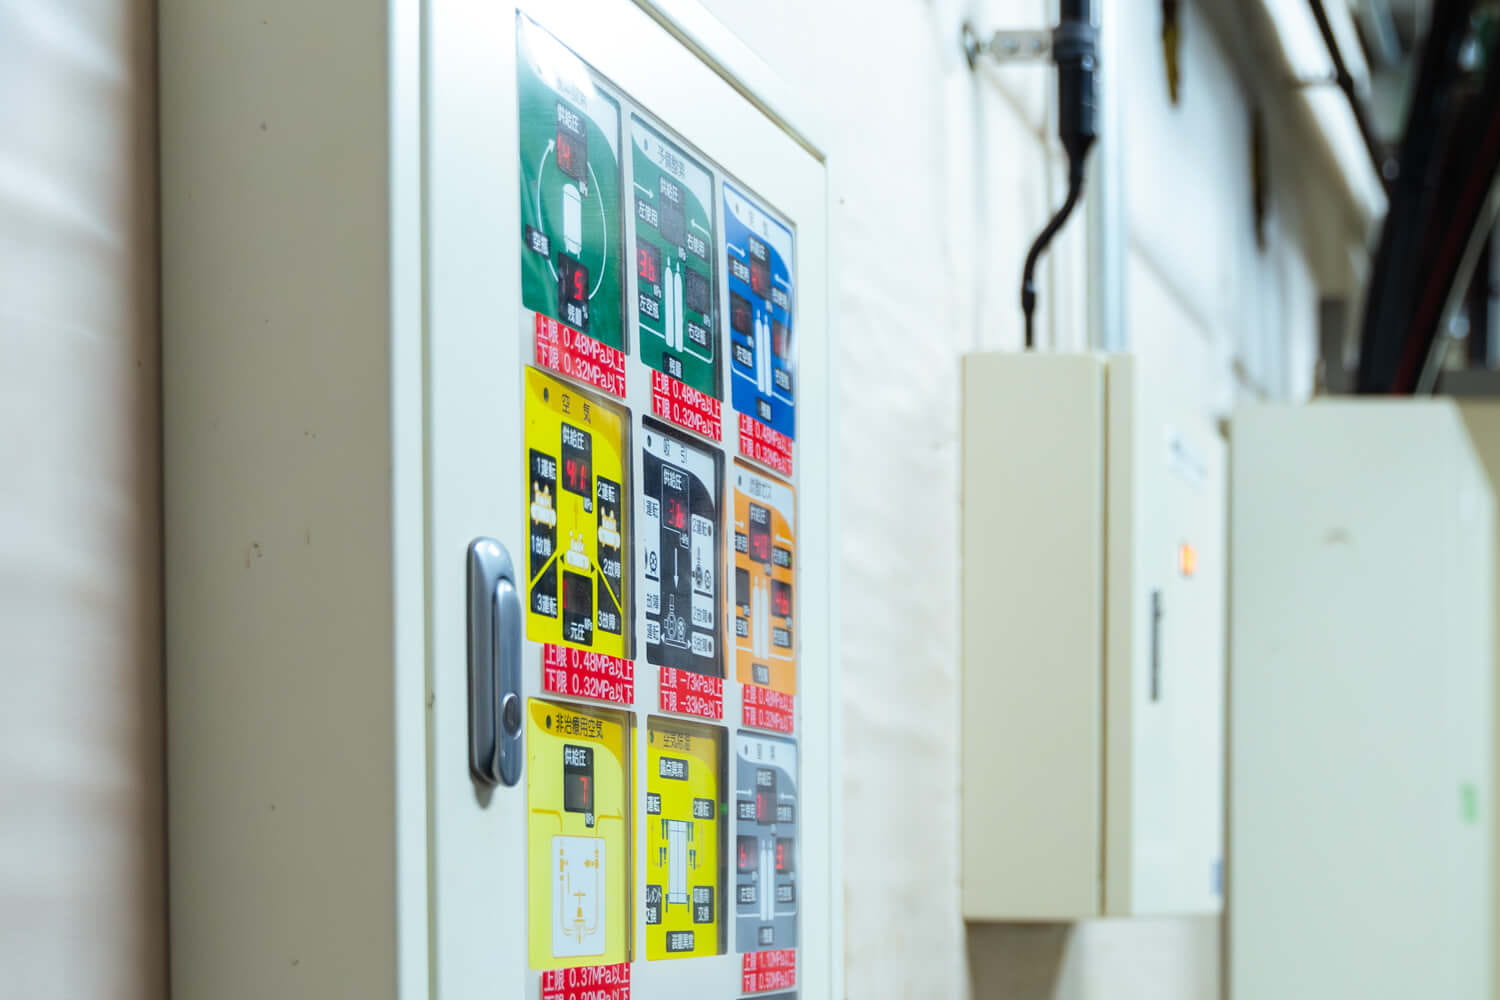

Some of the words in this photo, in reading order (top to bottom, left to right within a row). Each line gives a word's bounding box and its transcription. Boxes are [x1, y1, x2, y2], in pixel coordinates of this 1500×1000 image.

[537, 317, 559, 344] 上限
[563, 328, 625, 372] 0.48MPa以上
[537, 342, 559, 371] 下限
[563, 353, 625, 397] 0.32MPa以下
[654, 373, 670, 396] 上限
[654, 394, 670, 420] 下限
[673, 403, 721, 441] 0.32MPa以下
[562, 425, 585, 450] 供給圧
[536, 458, 556, 480] 1運転
[598, 480, 615, 502] 2運転
[532, 536, 551, 555] 1故障
[603, 558, 620, 578] 2故障
[537, 594, 557, 616] 3運転
[598, 610, 616, 630] 3故障
[570, 623, 584, 640] 元圧
[546, 645, 567, 668] 上限
[571, 650, 632, 681] 0.48MPa以上
[546, 669, 567, 693] 下限
[571, 674, 633, 704] 0.32MPa以下
[661, 668, 677, 688] 上限
[661, 691, 677, 711] 下限
[555, 712, 604, 739] 非治療用空気
[565, 747, 587, 767] 供給圧
[544, 968, 565, 991] 上限
[569, 963, 629, 988] 0.37MPa以上
